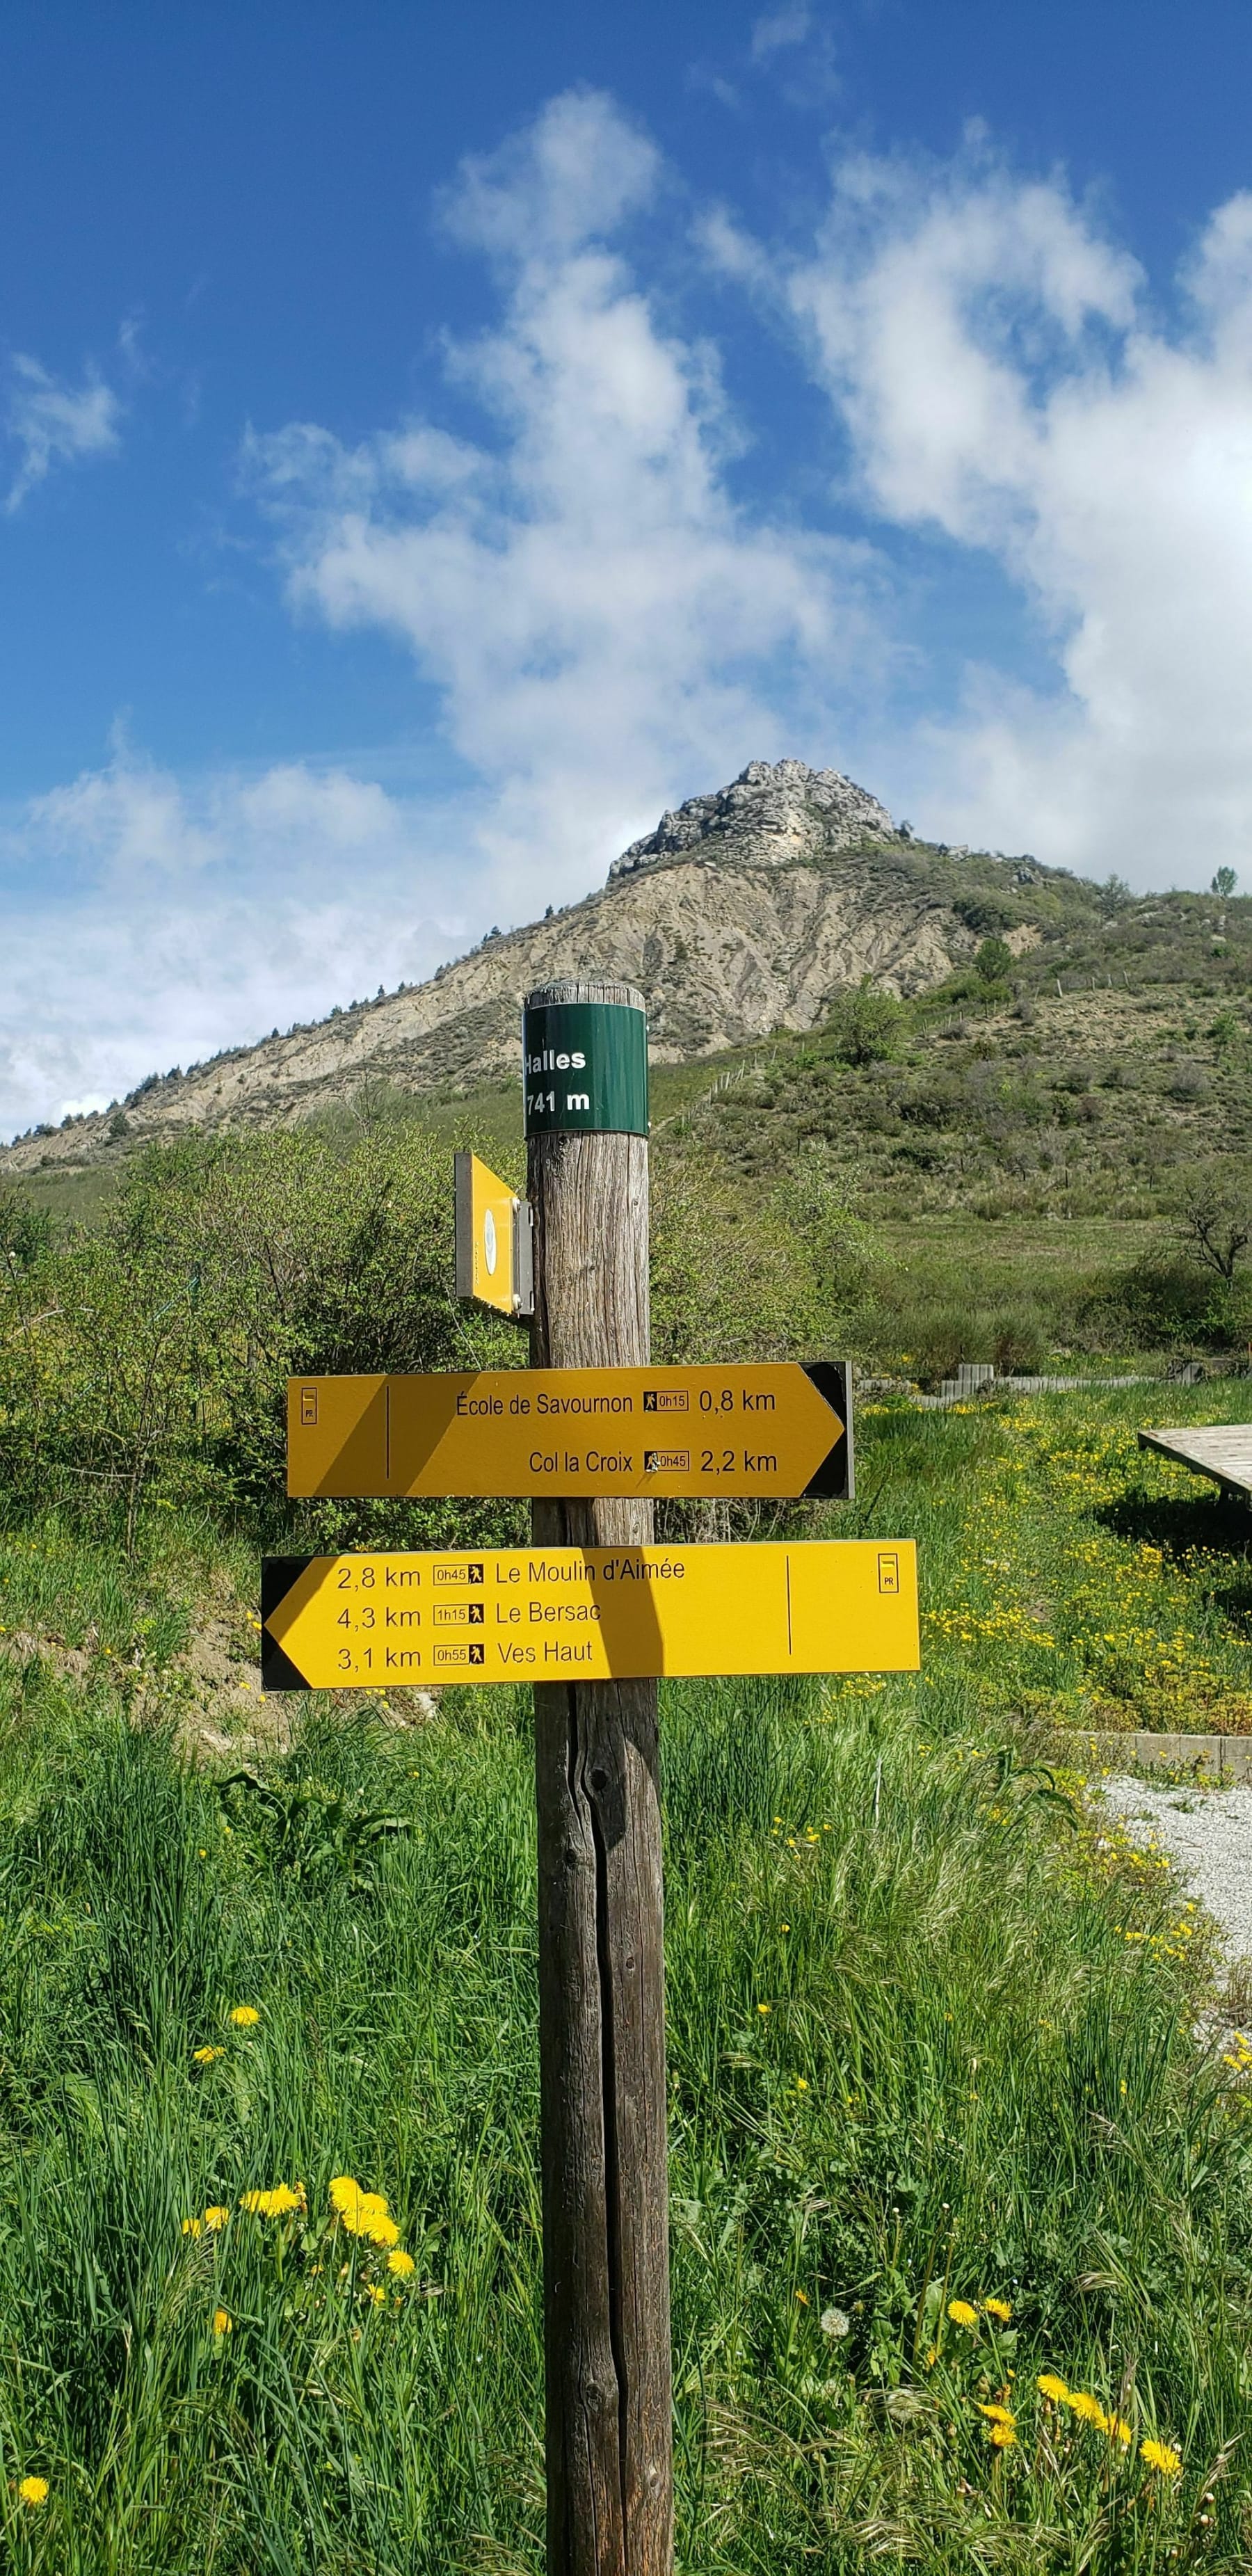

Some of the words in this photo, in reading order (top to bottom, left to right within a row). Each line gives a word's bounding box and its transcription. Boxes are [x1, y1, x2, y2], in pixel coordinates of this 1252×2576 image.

[524, 1049, 586, 1076] Halles
[527, 1090, 555, 1116] 741
[567, 1094, 590, 1110] m
[456, 1391, 504, 1416] École
[509, 1394, 531, 1414] de
[536, 1392, 633, 1414] Savournon
[659, 1395, 685, 1407] 0h15
[699, 1390, 734, 1414] 0,8
[742, 1389, 776, 1411] km
[529, 1451, 559, 1472] Col
[565, 1451, 580, 1471] la
[586, 1450, 633, 1472] Croix
[660, 1455, 686, 1466] 0h45
[700, 1450, 735, 1474] 2,2
[744, 1449, 778, 1471] km
[337, 1567, 376, 1592] 2,8
[385, 1567, 421, 1587] km
[437, 1568, 467, 1581] 0h45
[496, 1562, 520, 1583] Le
[528, 1559, 596, 1583] Moulin
[603, 1557, 685, 1581] d'Aimée
[884, 1577, 894, 1585] PR
[337, 1607, 376, 1632] 4,3
[385, 1606, 421, 1627] km
[438, 1608, 466, 1620] 1h15
[497, 1603, 520, 1623] Le
[529, 1601, 601, 1622] Bersac
[338, 1647, 374, 1673] 3,1
[385, 1647, 422, 1667] km
[438, 1649, 467, 1661] 0h55
[497, 1642, 536, 1663] Ves
[544, 1641, 593, 1662] Haut
